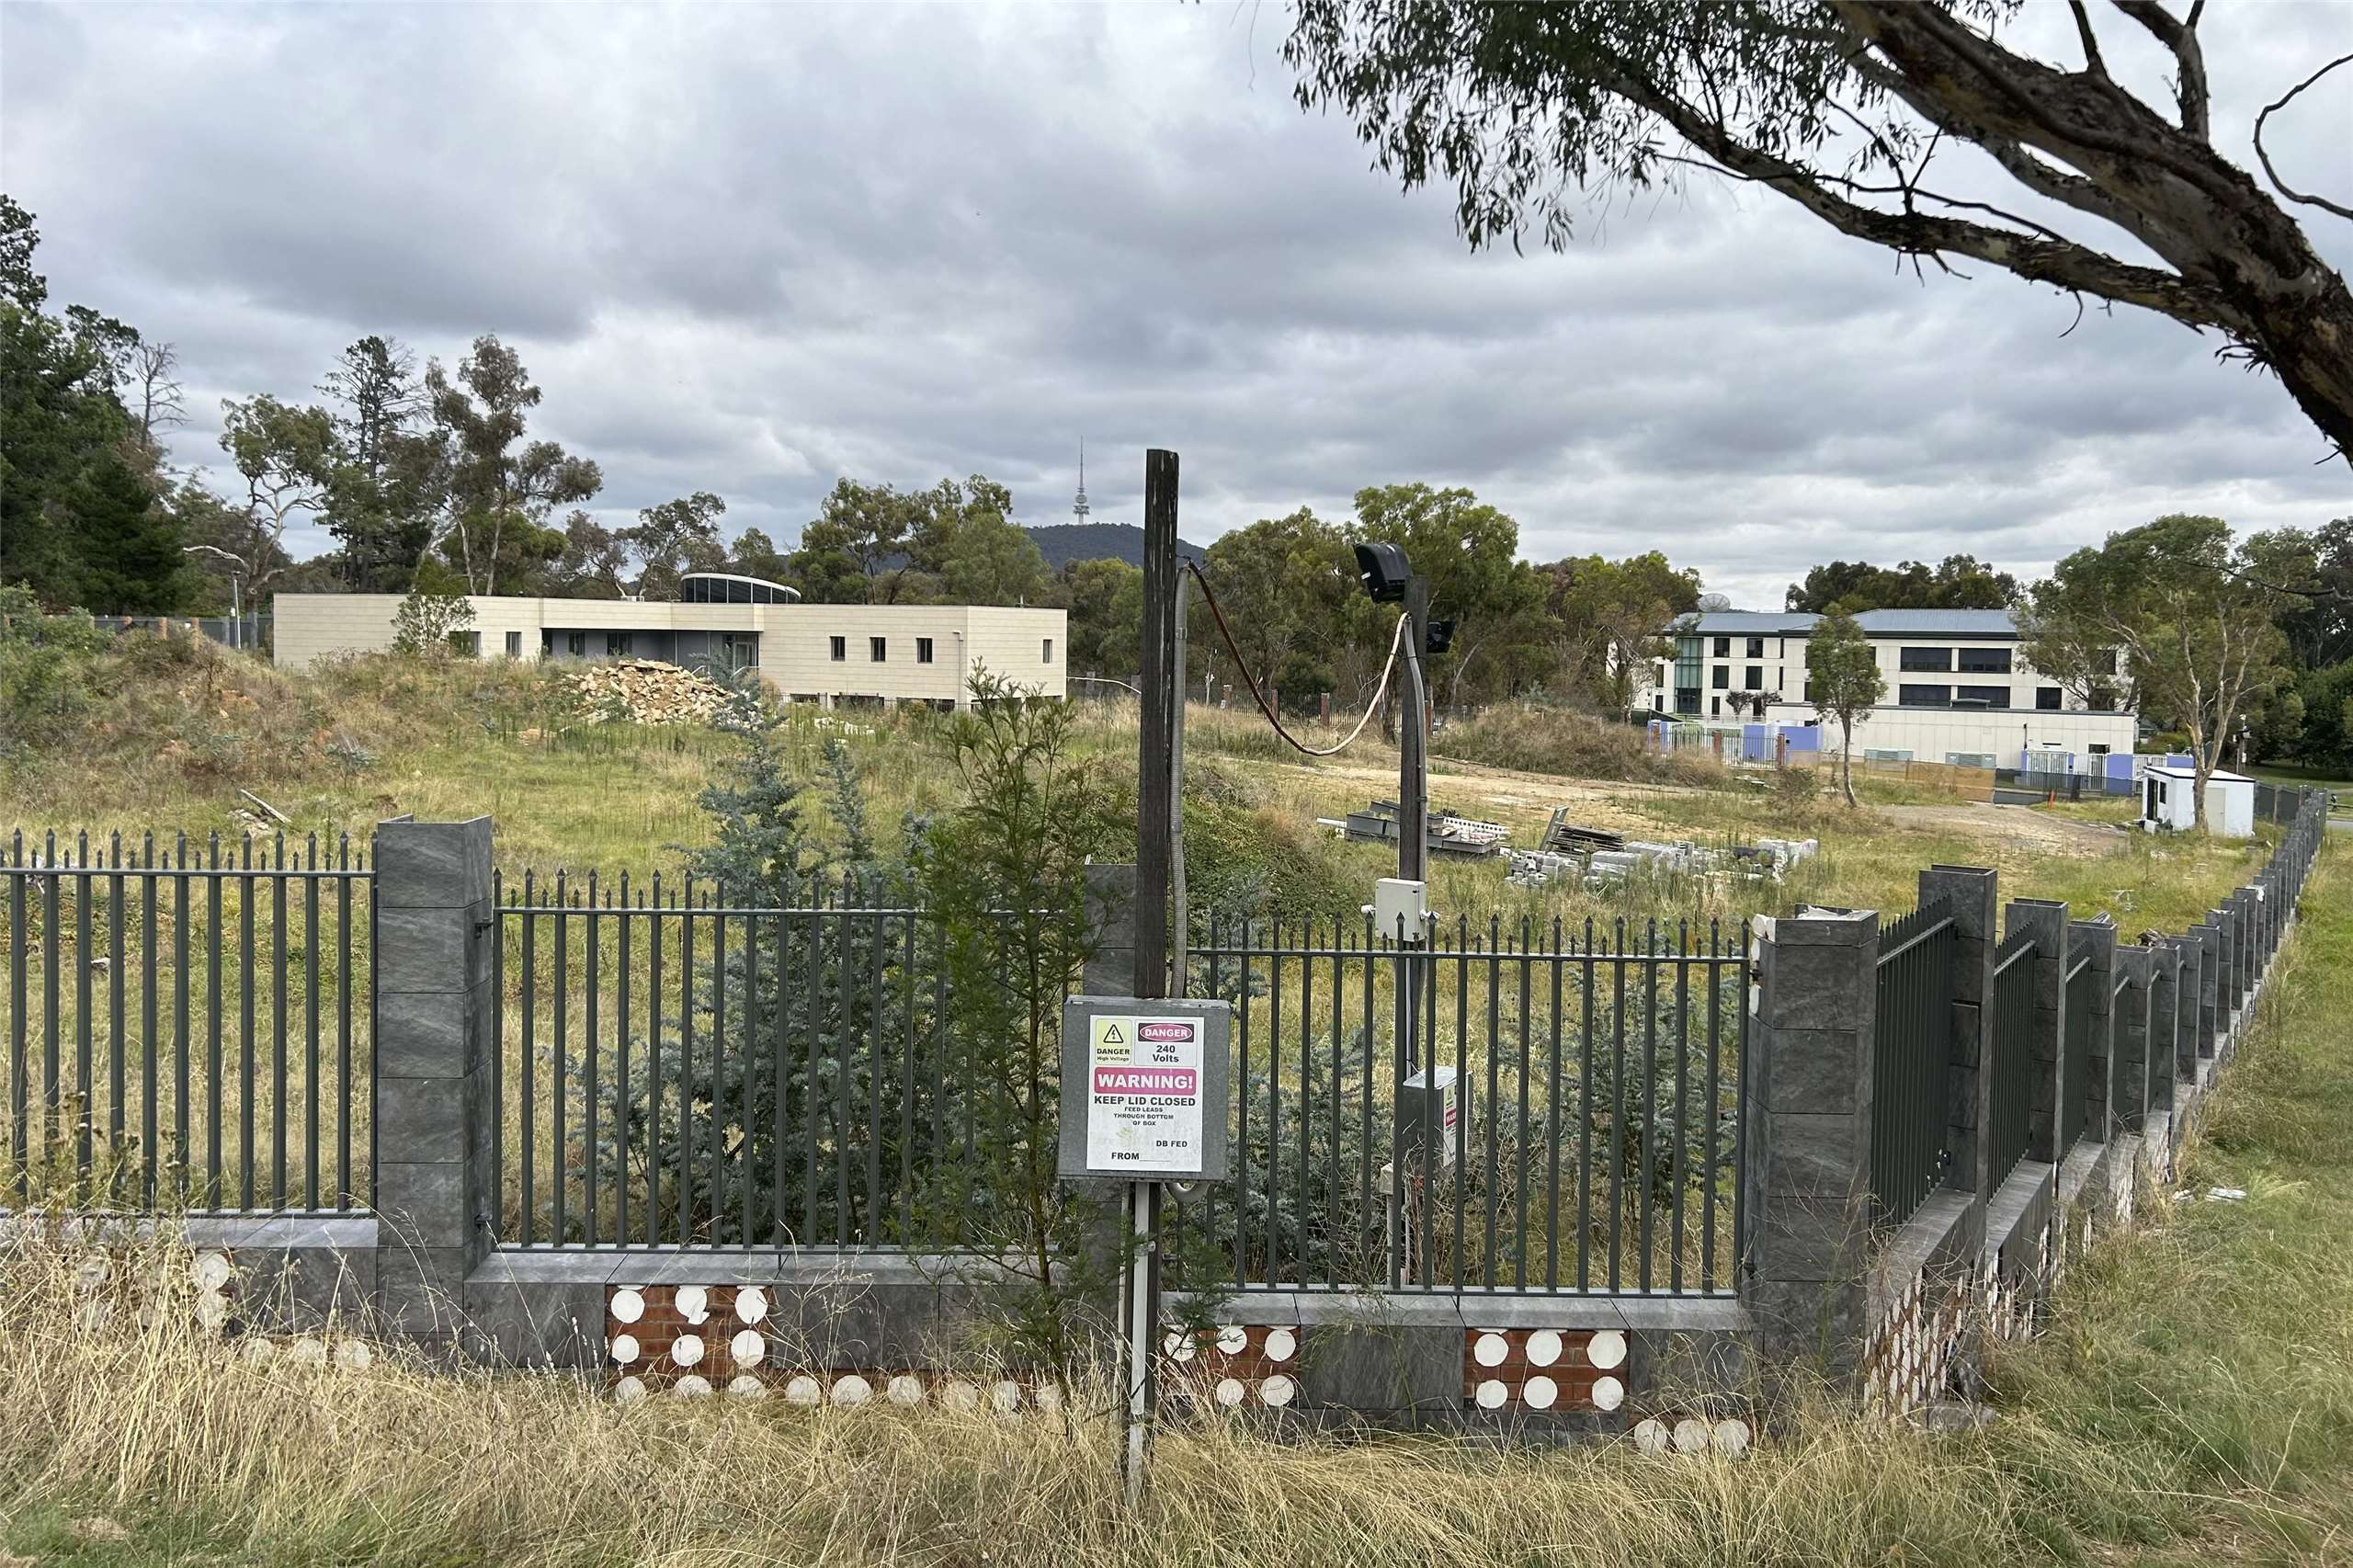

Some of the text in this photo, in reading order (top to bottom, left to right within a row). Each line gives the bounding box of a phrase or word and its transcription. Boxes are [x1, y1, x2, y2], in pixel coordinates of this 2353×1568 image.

[1144, 1028, 1188, 1038] DANGER
[1156, 1044, 1176, 1053] 240
[1153, 1053, 1179, 1062] Volts
[1097, 1074, 1193, 1089] WARNING!
[1094, 1095, 1196, 1107] KEEP LID CLOSED
[1170, 1140, 1188, 1148] FED
[1111, 1152, 1140, 1160] FROM
